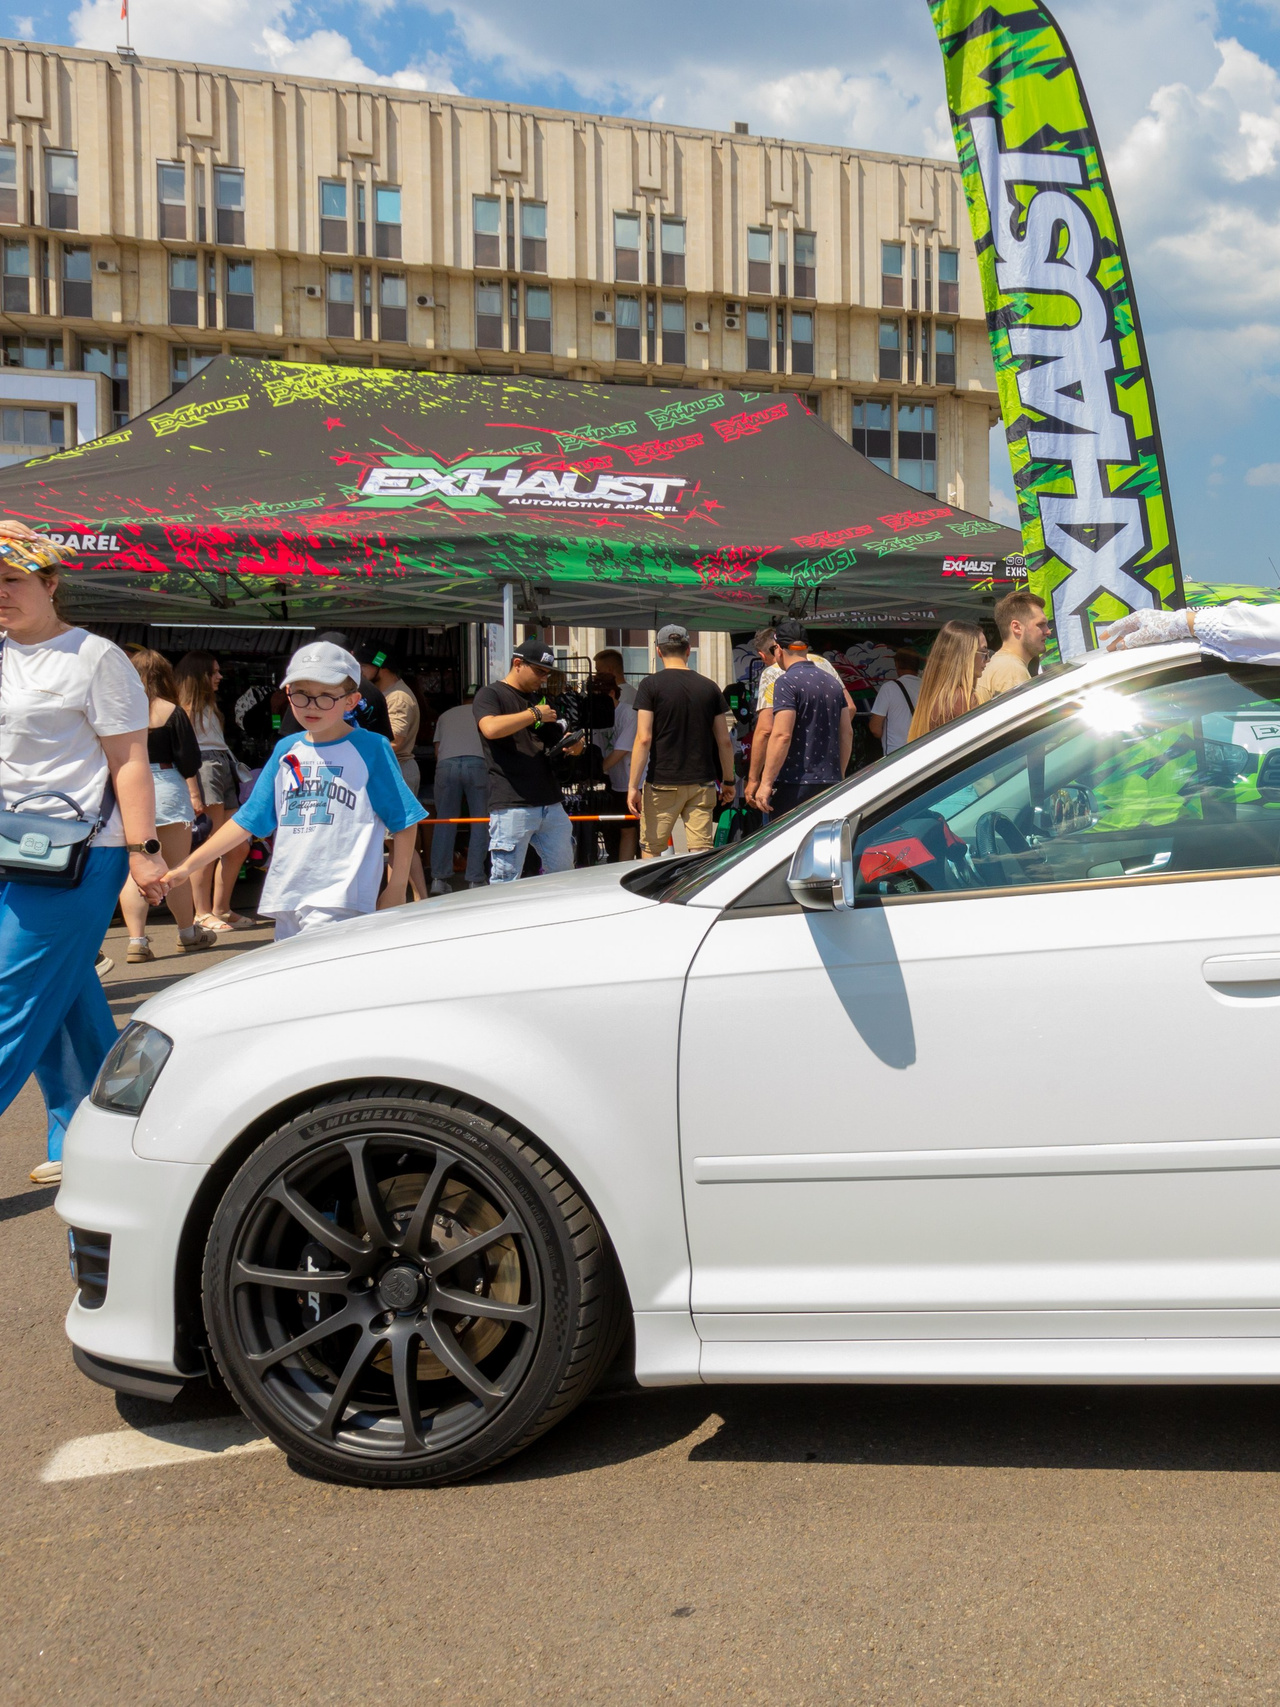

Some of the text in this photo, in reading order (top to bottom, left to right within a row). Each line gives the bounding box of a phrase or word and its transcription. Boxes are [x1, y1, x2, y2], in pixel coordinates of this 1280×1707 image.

[970, 116, 1162, 664] XHAUST
[148, 394, 250, 437] EXHAUST
[645, 393, 724, 431] EXHAUST
[710, 403, 788, 443] EXHAUST
[552, 421, 638, 452] EXHAUST
[350, 457, 687, 508] EXHAUST
[508, 497, 679, 513] AUTOMOTIVE APPAREL
[876, 508, 954, 532] EXHAUST
[39, 533, 121, 551] PAREL
[941, 556, 996, 577] EXHAUST
[282, 779, 357, 811] LLYWOOD
[324, 1108, 417, 1130] MICHELIN
[426, 1117, 462, 1136] 225/40
[356, 1460, 448, 1481] MICHELIN
